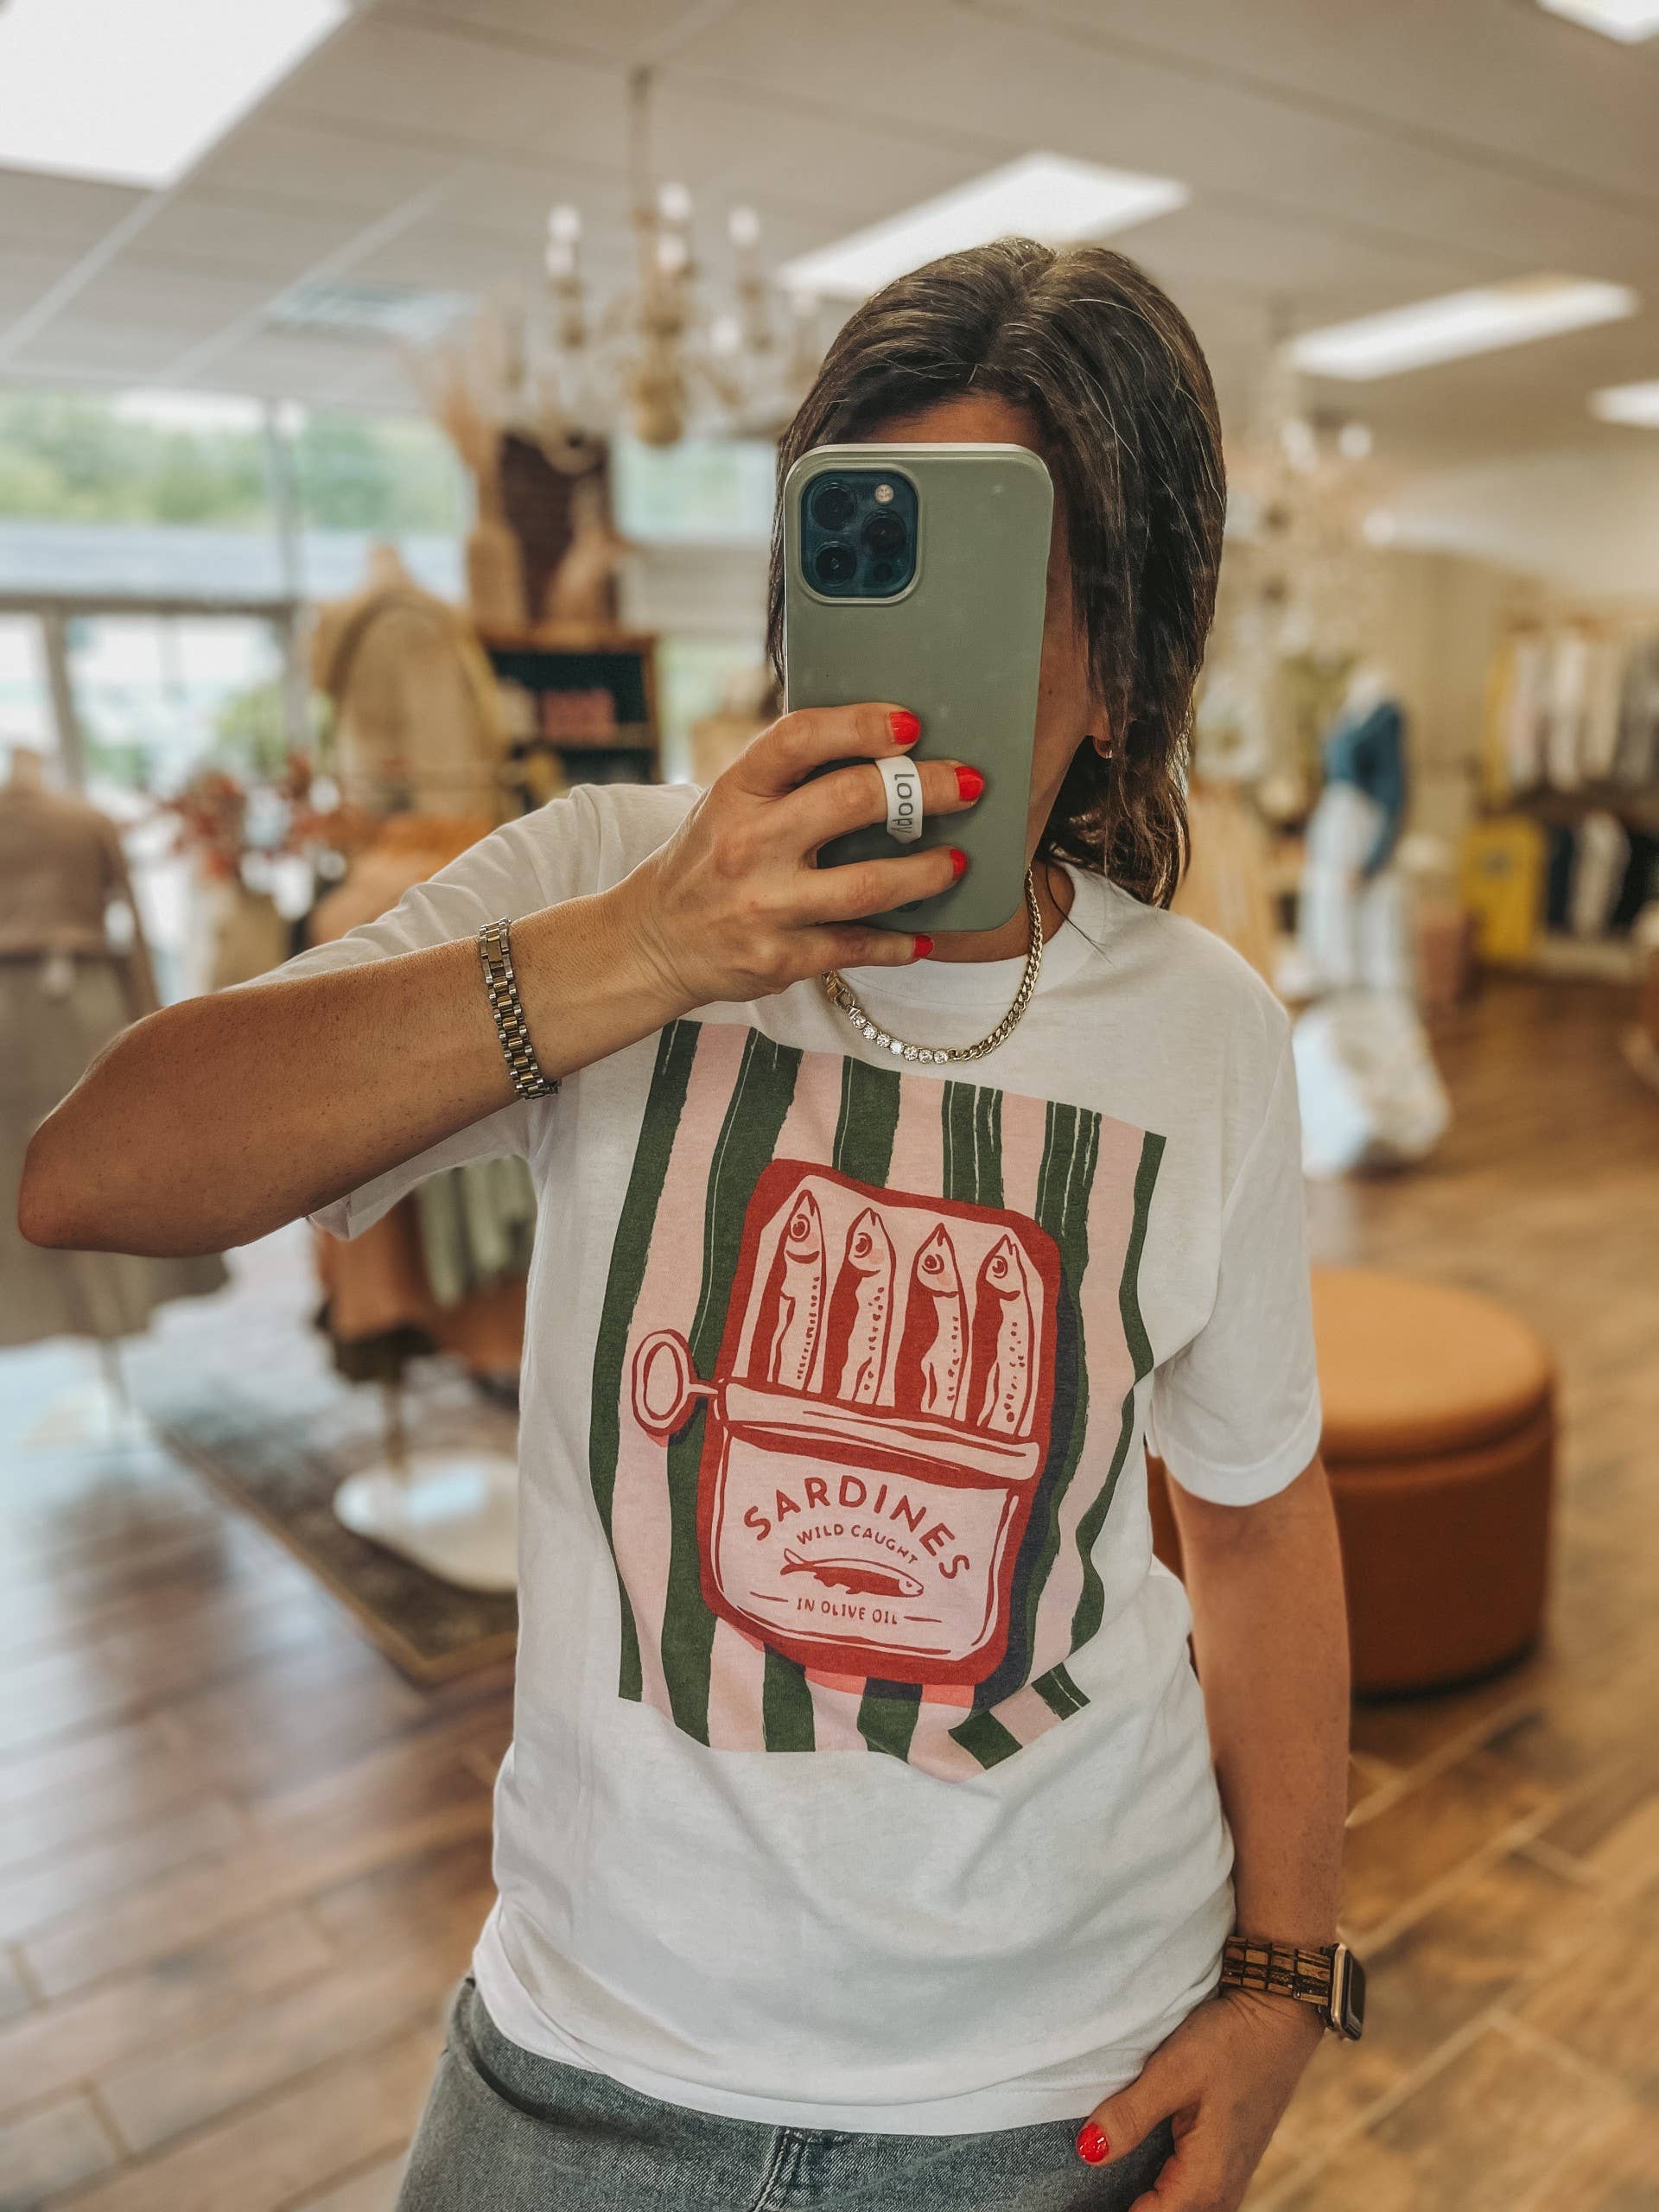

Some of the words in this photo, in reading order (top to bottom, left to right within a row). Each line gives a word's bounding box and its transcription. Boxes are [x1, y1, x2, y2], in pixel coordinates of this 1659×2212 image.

[743, 1474, 970, 1580] SARDINES
[796, 1523, 844, 1545] WILD
[850, 1524, 918, 1565] CAUGHT
[796, 1598, 816, 1611] IN
[821, 1600, 866, 1621] OLIVE
[872, 1609, 899, 1624] OIL
